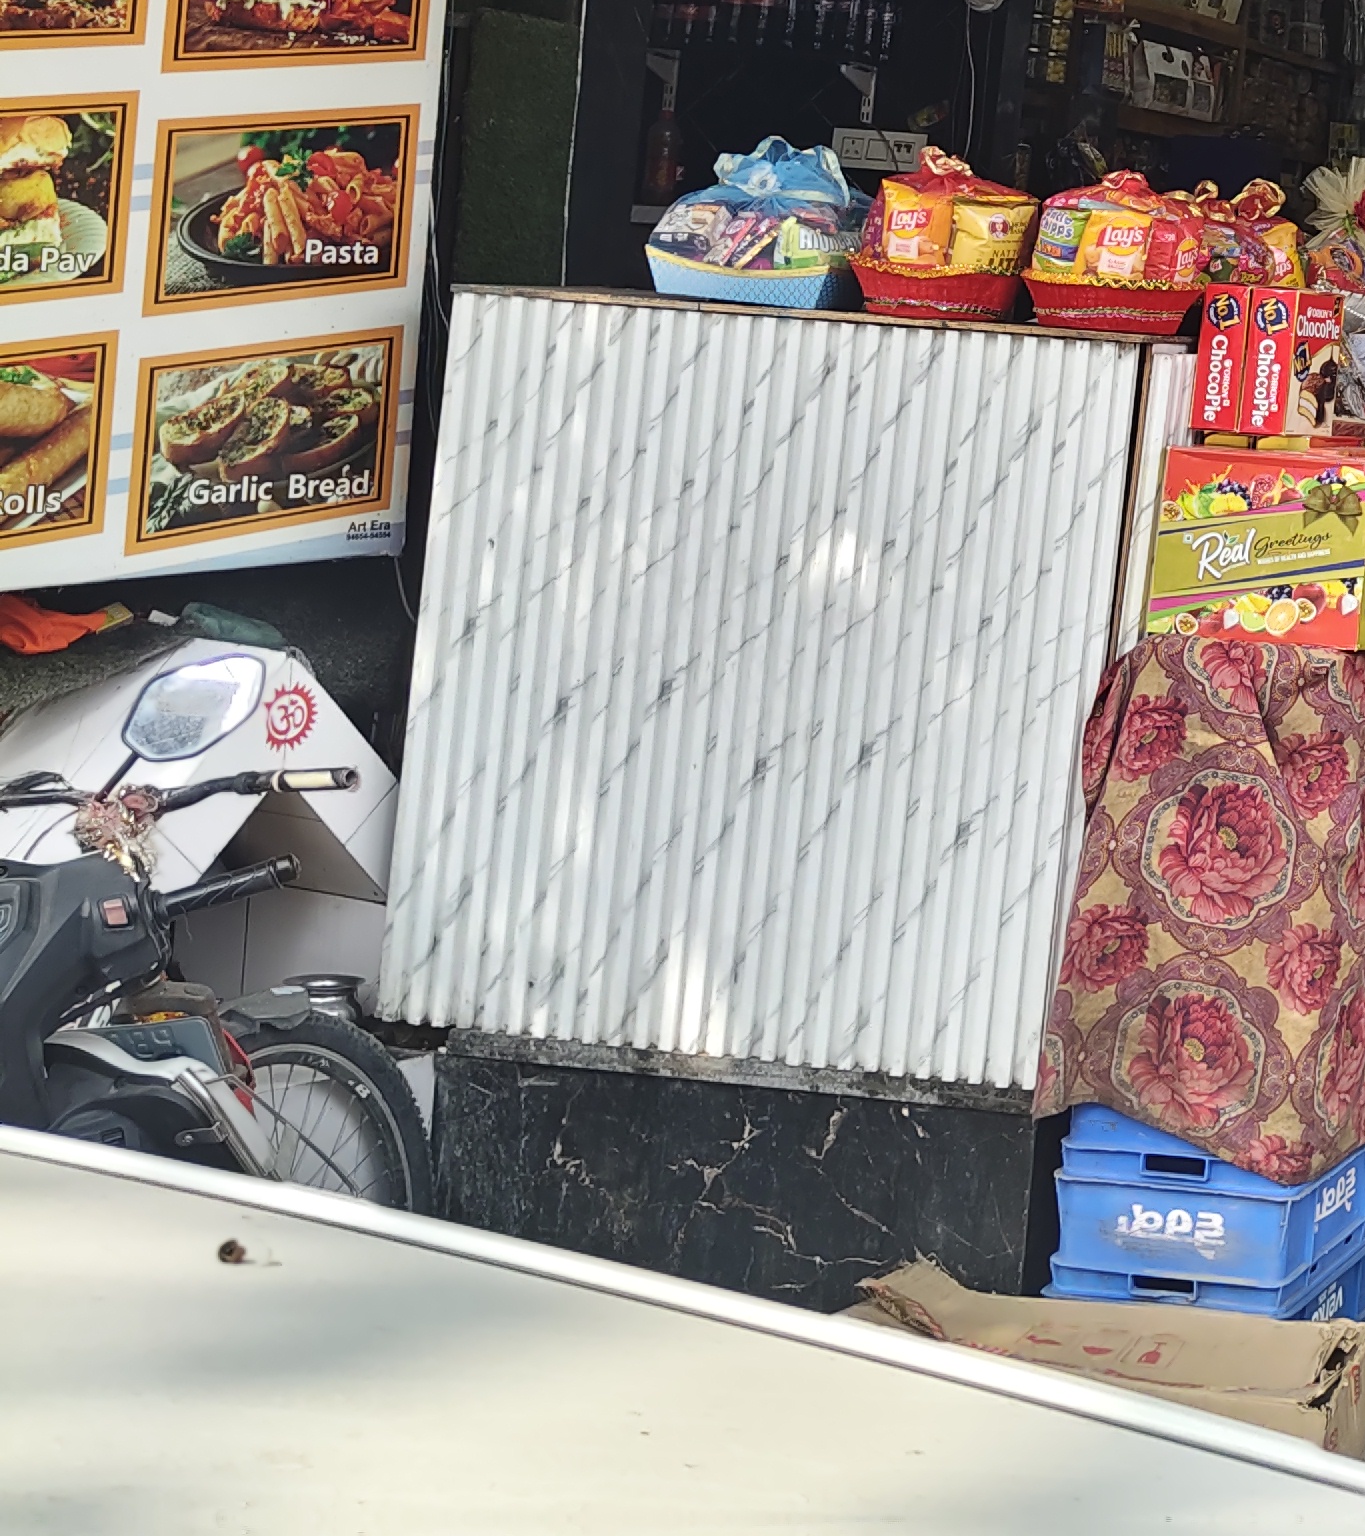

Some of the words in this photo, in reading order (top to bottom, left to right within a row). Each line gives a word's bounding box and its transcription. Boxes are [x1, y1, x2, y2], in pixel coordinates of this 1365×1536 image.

[890, 209, 928, 231] Lay's
[1102, 226, 1145, 246] Lay's
[40, 248, 95, 272] Pav
[305, 239, 379, 266] Pasta
[1296, 315, 1340, 340] ChocoPie
[1203, 335, 1229, 422] ChocoPie
[1252, 339, 1276, 426] ChocoPie
[188, 475, 273, 506] Garlic
[288, 471, 371, 500] Bread
[1192, 528, 1257, 580] Real
[1254, 532, 1332, 557] Greetings
